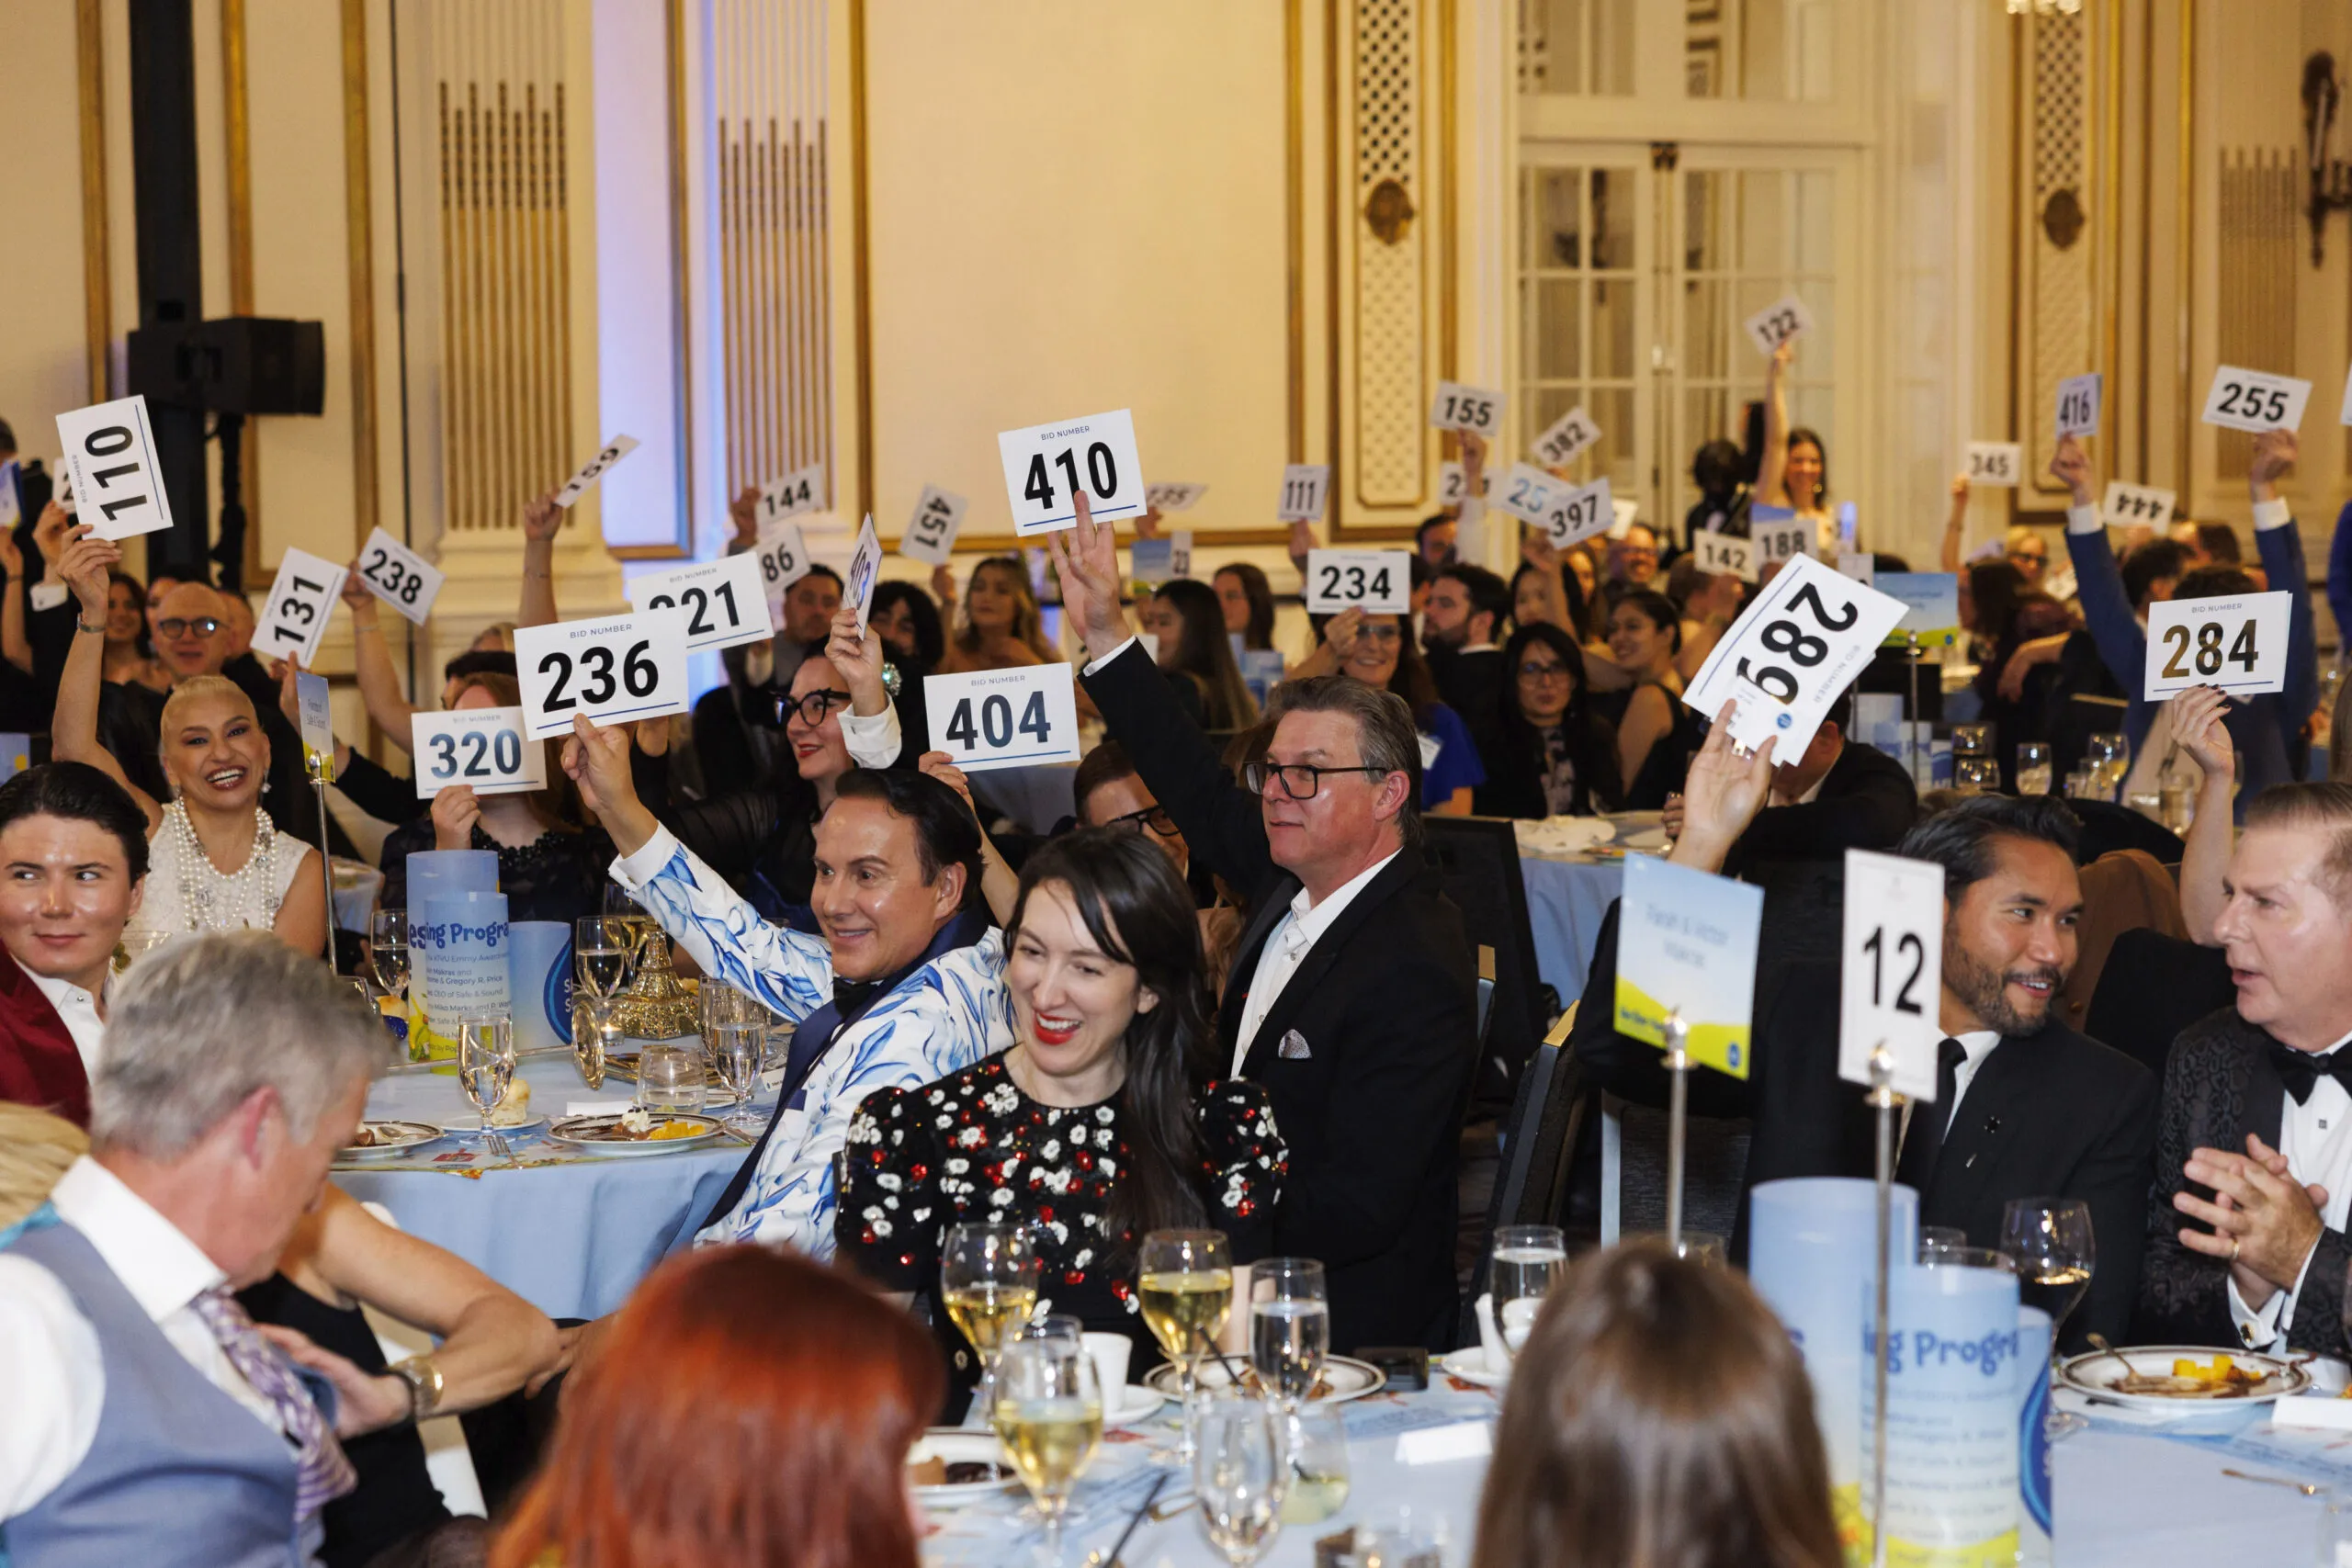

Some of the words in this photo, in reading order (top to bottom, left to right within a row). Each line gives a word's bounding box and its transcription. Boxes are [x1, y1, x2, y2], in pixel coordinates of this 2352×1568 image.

[1758, 309, 1801, 344] 122
[1444, 395, 1494, 427] 155
[2059, 389, 2090, 428] 416
[2217, 381, 2290, 423] 255
[1040, 432, 1056, 441] BID
[1057, 425, 1090, 437] NUMBER
[72, 454, 84, 488] NUMBER
[85, 425, 147, 522] 110
[1024, 441, 1117, 510] 410
[1971, 454, 2009, 478] 345
[764, 479, 811, 517] 144
[1286, 479, 1317, 512] 111
[1446, 473, 1490, 497] 21
[1508, 478, 1549, 513] 25
[913, 495, 952, 551] 451
[1550, 493, 1598, 537] 397
[762, 544, 794, 583] 86
[1704, 542, 1746, 570] 142
[364, 547, 423, 605] 238
[670, 575, 683, 583] BID
[684, 568, 718, 580] NUMBER
[1319, 565, 1392, 600] 234
[274, 575, 324, 644] 131
[2191, 605, 2206, 614] BID
[2208, 603, 2243, 613] NUMBER
[570, 629, 588, 639] BID
[590, 624, 633, 636] NUMBER
[1736, 581, 1859, 705] 289
[2162, 618, 2259, 679] 284
[537, 639, 659, 714] 236
[970, 677, 987, 687] BID
[989, 674, 1026, 685] NUMBER
[469, 714, 502, 723] NUMBER
[945, 690, 1052, 750] 404
[429, 728, 522, 779] 320
[446, 976, 476, 987] Gregory
[1862, 924, 1924, 1017] 12
